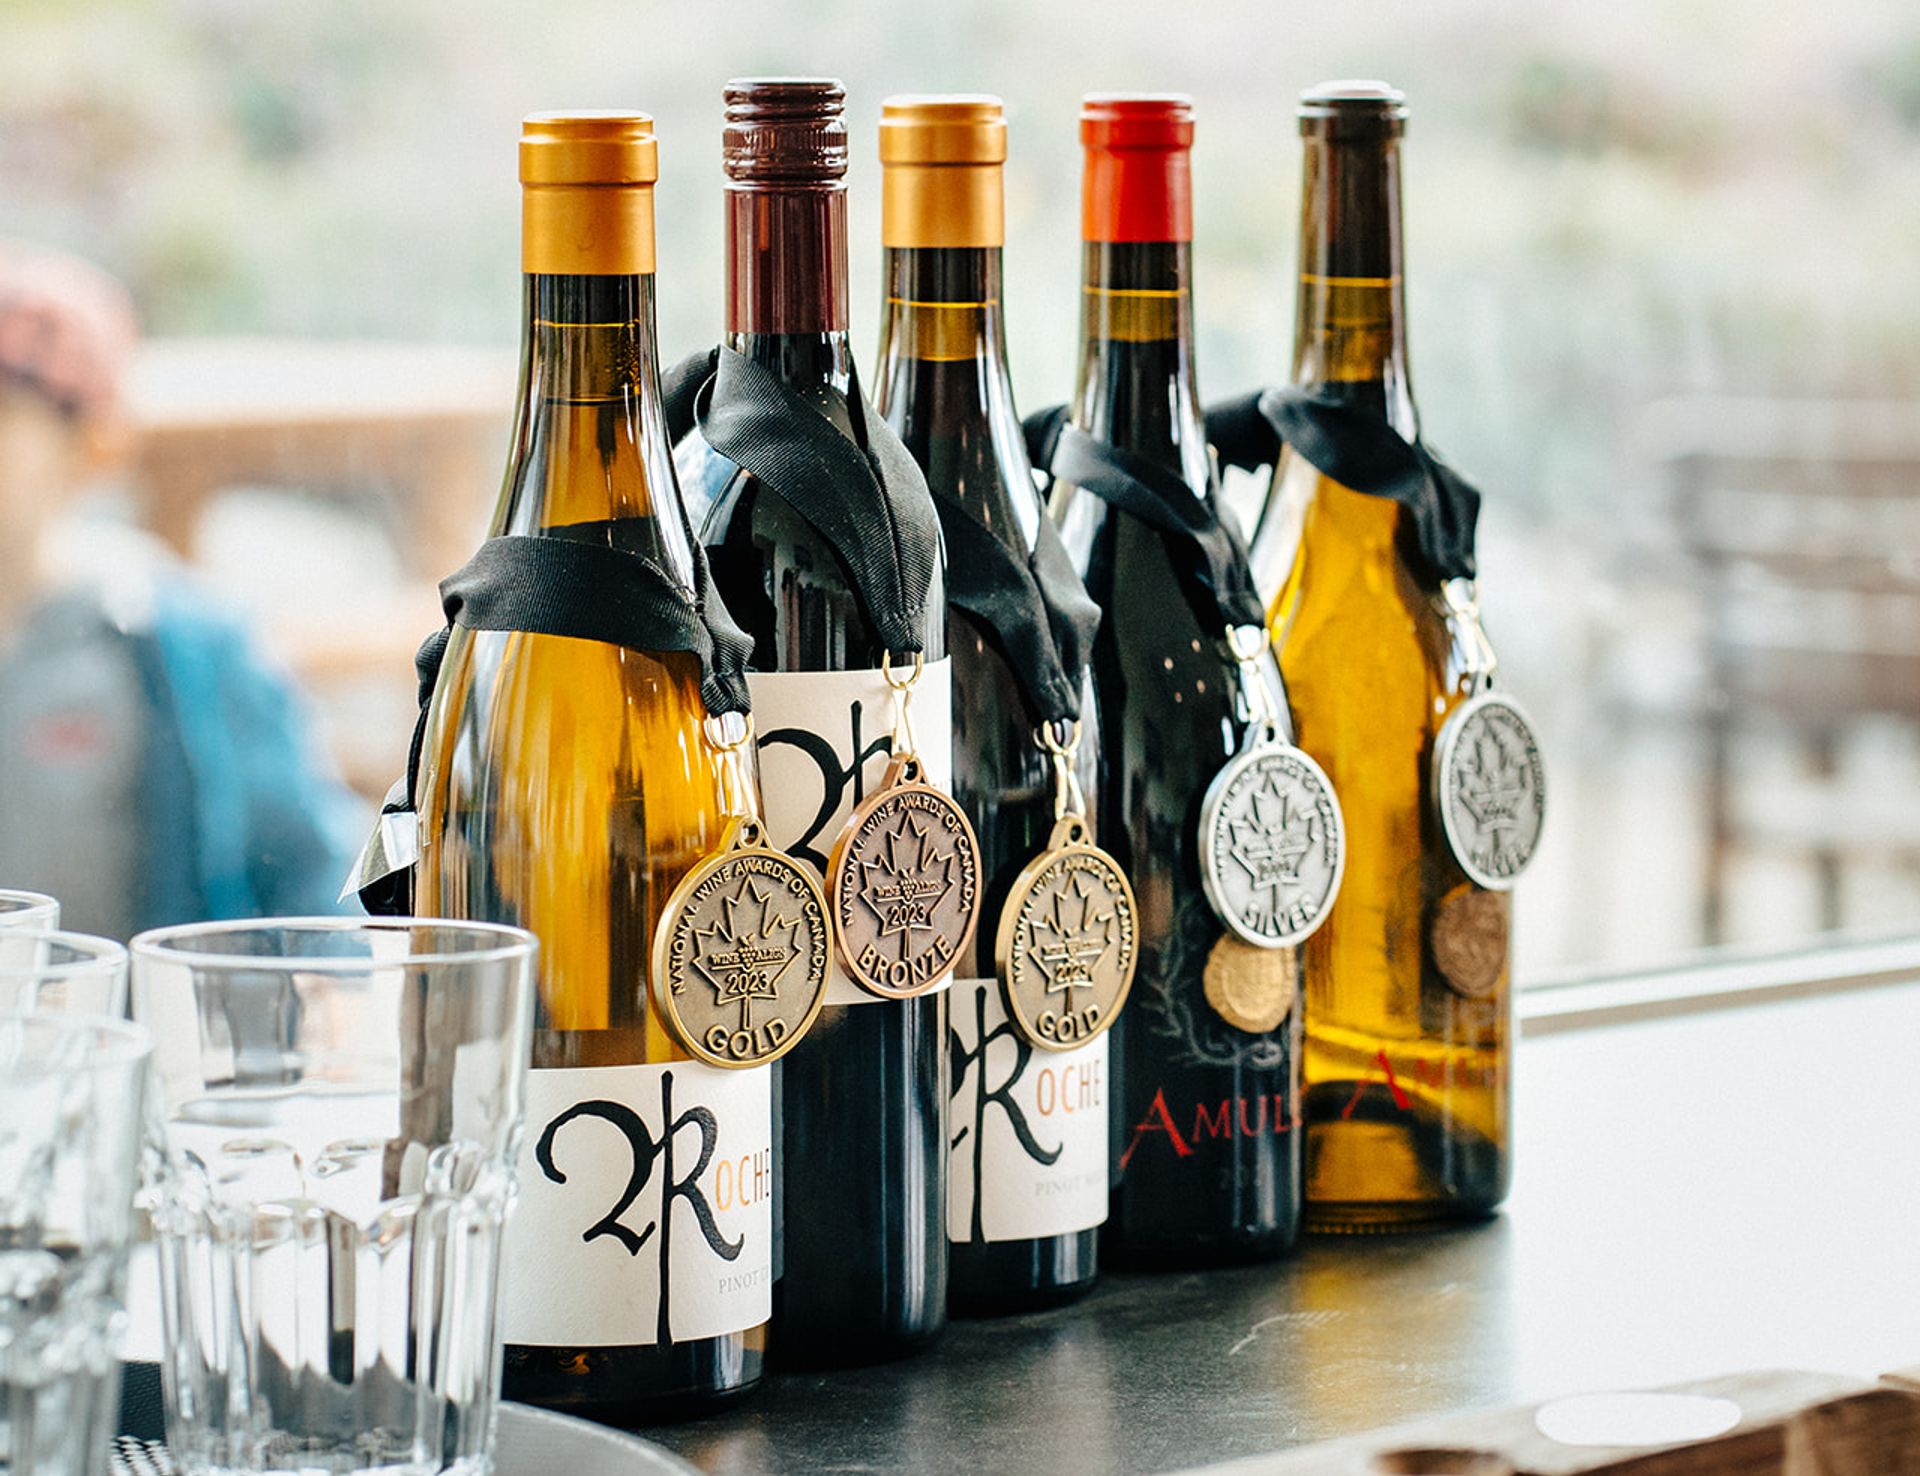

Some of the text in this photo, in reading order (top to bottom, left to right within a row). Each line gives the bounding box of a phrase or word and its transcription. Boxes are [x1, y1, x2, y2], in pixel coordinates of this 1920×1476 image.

[840, 793, 975, 926] NATIONAL WINE AWARDS OF CANADA
[670, 858, 826, 996] NATIONAL WINE AWARDS OF CANADA
[888, 901, 927, 926] 2023
[858, 934, 954, 987] BRONZE
[726, 970, 770, 994] 2023
[704, 1018, 789, 1058] GOLD
[1036, 1003, 1100, 1043] GOLD
[718, 1268, 761, 1295] PINOT
